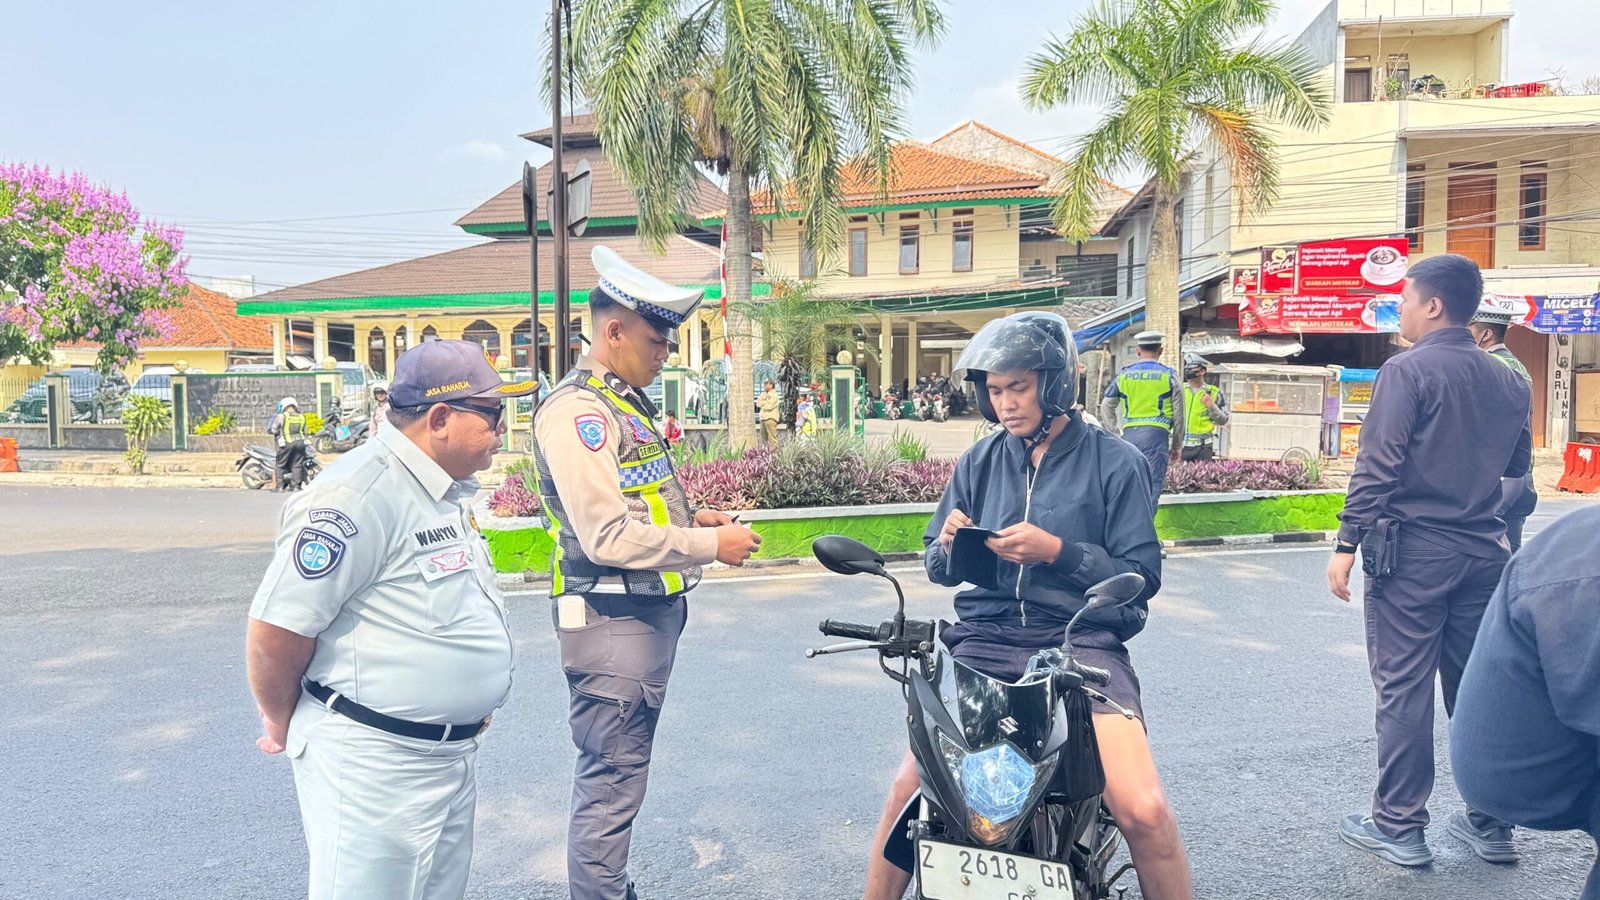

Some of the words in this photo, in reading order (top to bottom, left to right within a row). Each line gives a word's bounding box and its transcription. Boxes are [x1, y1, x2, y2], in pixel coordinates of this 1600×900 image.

[1325, 246, 1347, 254] Mampir
[1283, 303, 1299, 311] Agar
[1301, 302, 1331, 310] Inspirasi
[1332, 302, 1363, 310] Mengalir
[1283, 310, 1308, 318] Bareng
[1124, 371, 1162, 381] POLISI
[425, 387, 442, 397] JASA
[441, 380, 471, 393] RAHARJA
[312, 511, 338, 520] CABANG
[415, 525, 457, 547] WAHYU
[302, 532, 316, 541] JASA
[317, 536, 340, 553] RAHARJA
[921, 844, 935, 869] Z
[959, 850, 1019, 881] 2618
[1040, 863, 1070, 892] GA
